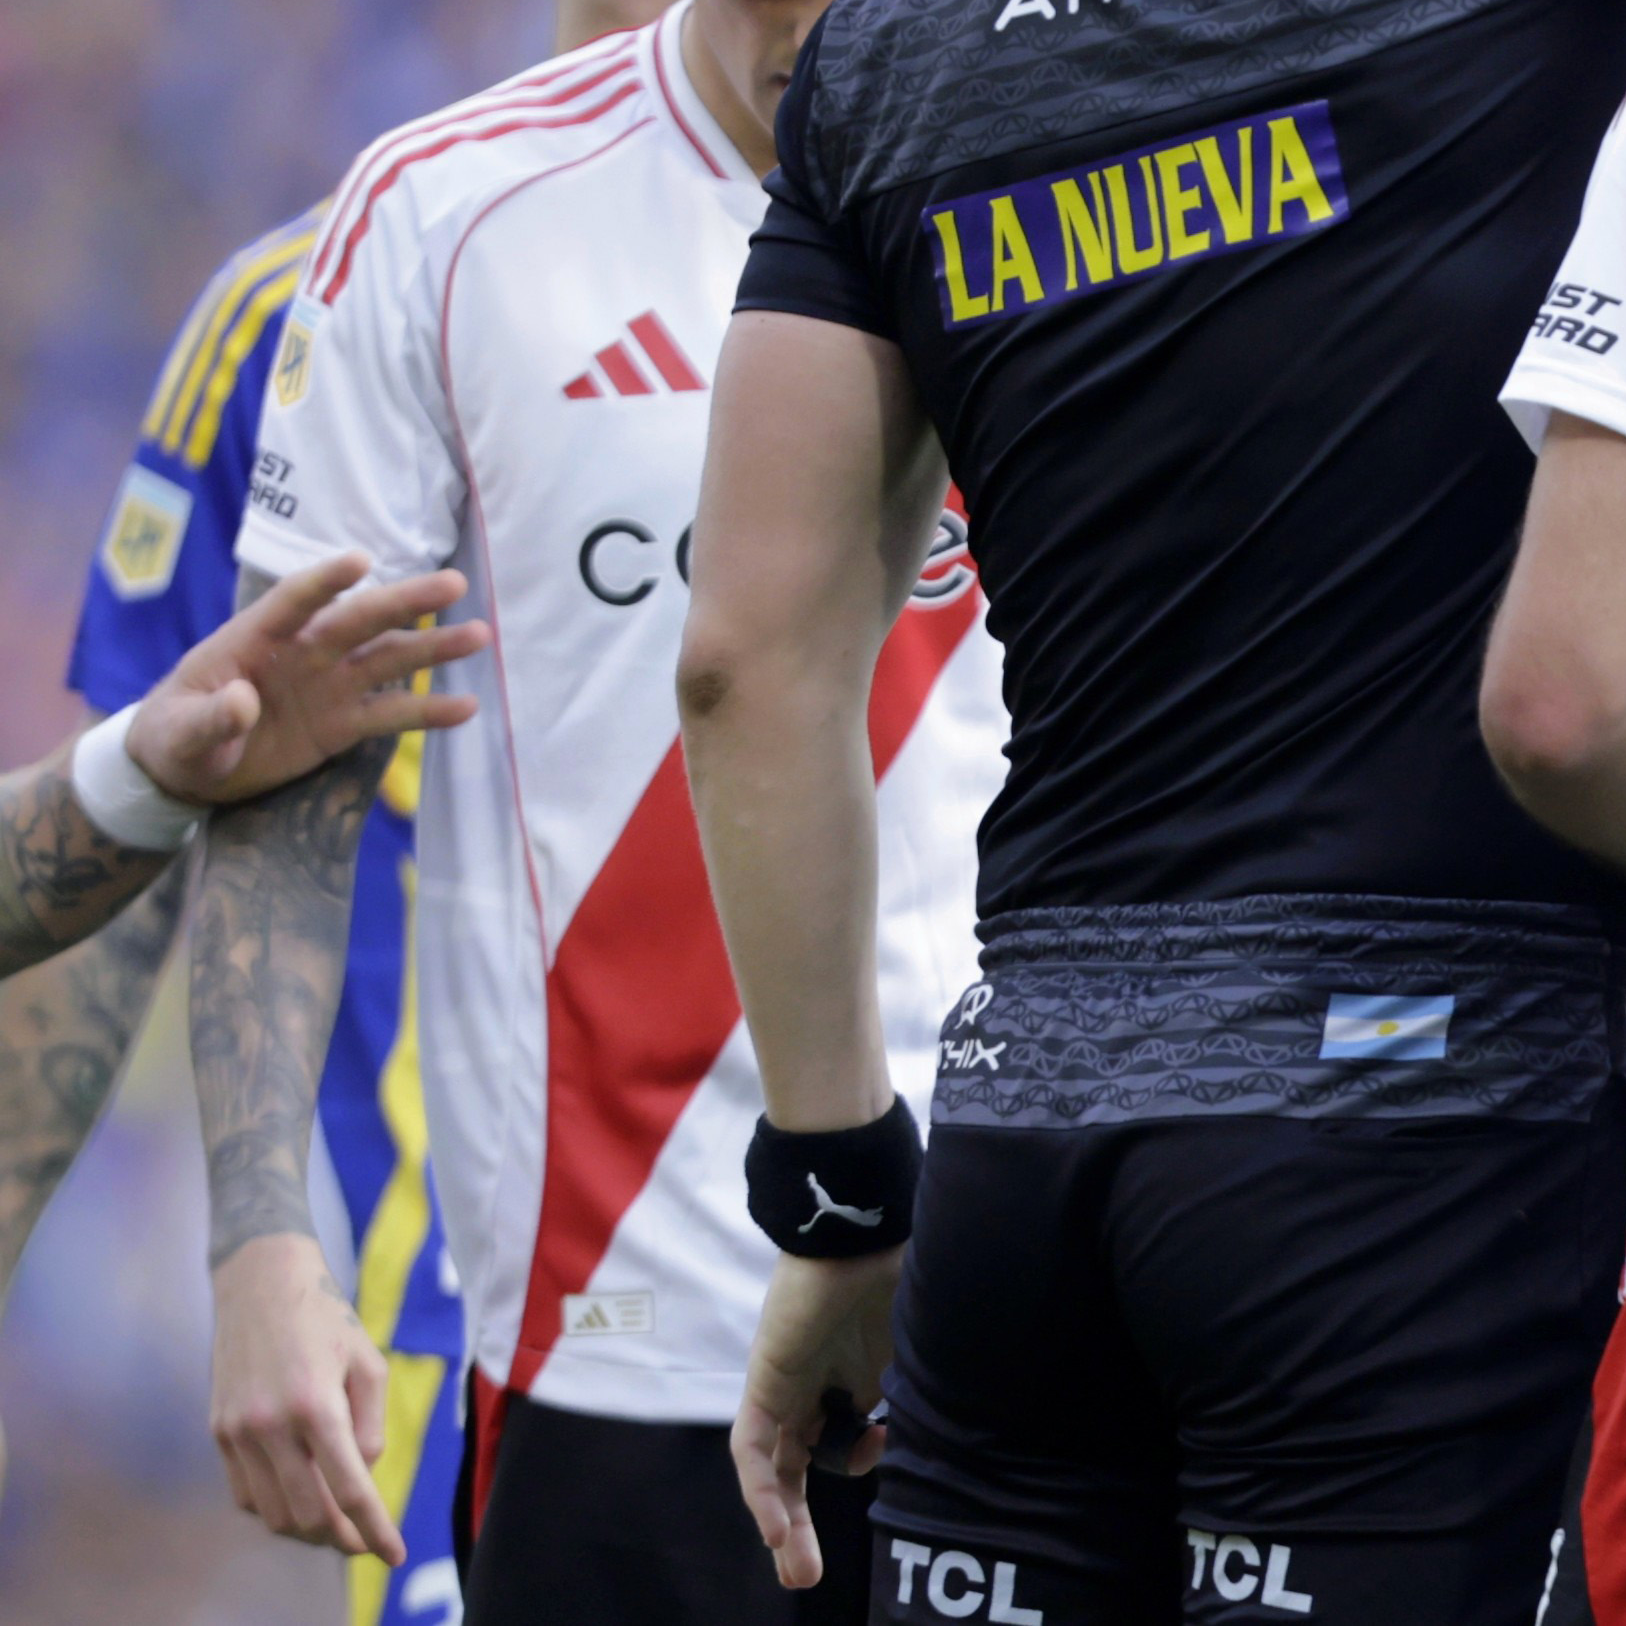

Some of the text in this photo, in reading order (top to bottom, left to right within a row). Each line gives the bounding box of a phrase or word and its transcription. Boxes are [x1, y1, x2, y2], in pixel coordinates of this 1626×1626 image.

[932, 116, 1333, 322] LA NUEVA
[890, 1538, 1043, 1626] TCL
[1187, 1529, 1313, 1614] TCL
